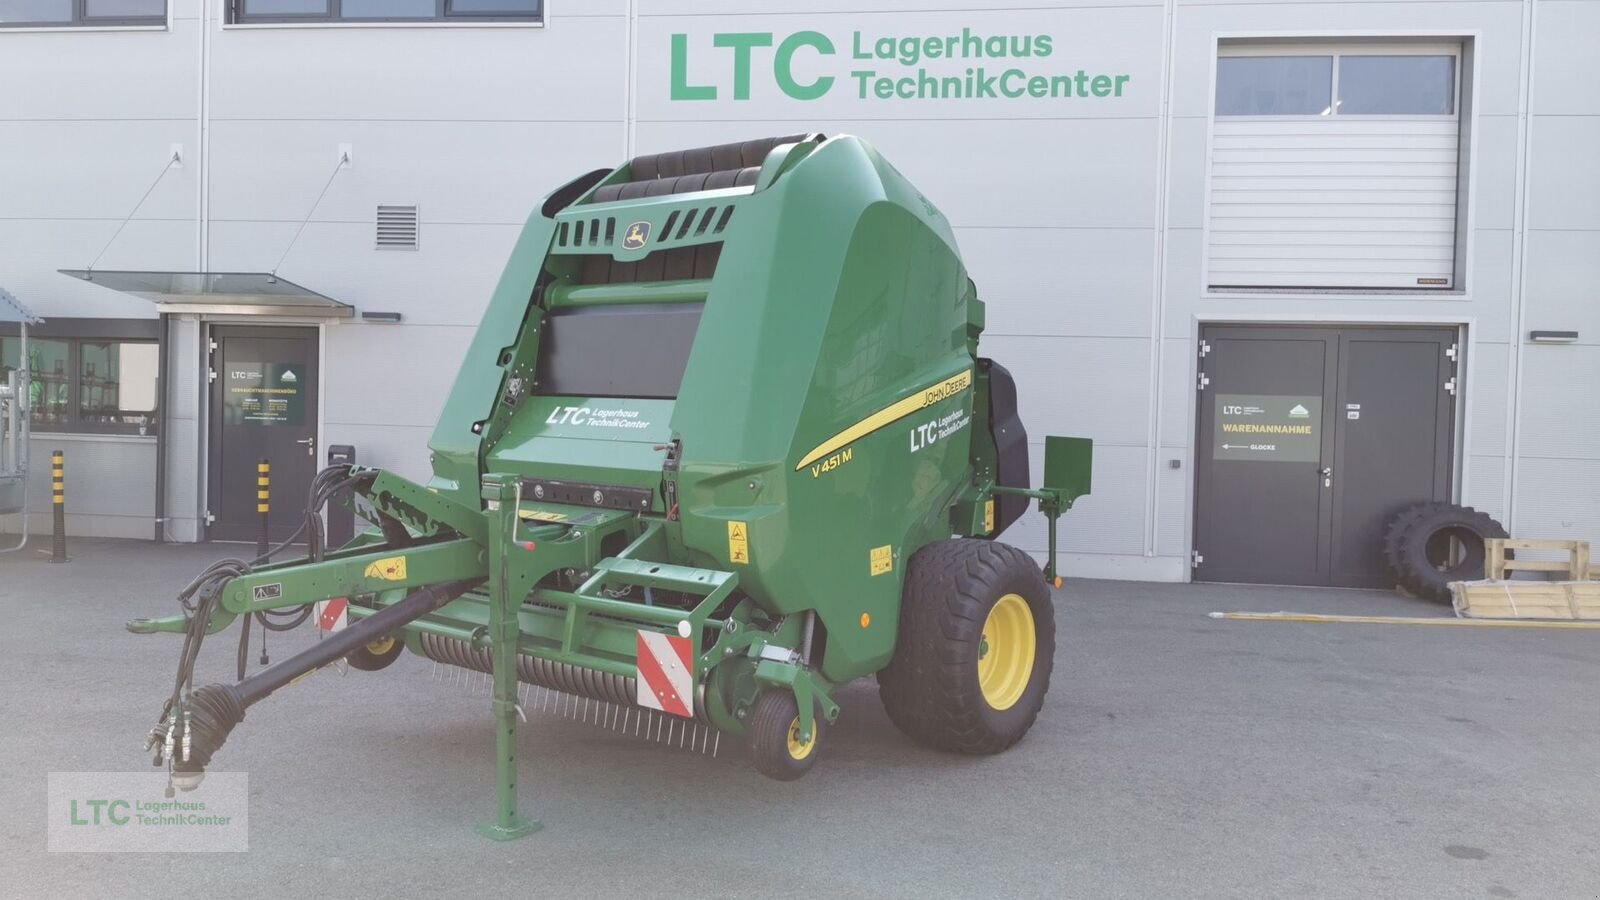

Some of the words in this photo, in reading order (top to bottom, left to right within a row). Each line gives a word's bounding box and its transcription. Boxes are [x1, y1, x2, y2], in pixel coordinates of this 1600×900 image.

[853, 28, 1054, 66] Lagerhaus
[670, 30, 836, 101] LTC
[851, 68, 1131, 100] TechnikCenter
[231, 371, 246, 379] LTC
[923, 389, 944, 405] JOHN
[945, 376, 967, 396] DEERE
[545, 406, 590, 425] LTC
[592, 408, 639, 418] Lagerhaus
[938, 409, 964, 427] Lagerhaus
[1223, 405, 1242, 415] LTC
[587, 418, 650, 429] TechnikCenter
[1223, 423, 1312, 434] WARENANNAHME
[910, 420, 938, 453] LTC
[811, 465, 820, 478] V
[821, 455, 841, 473] 451
[842, 447, 853, 463] M
